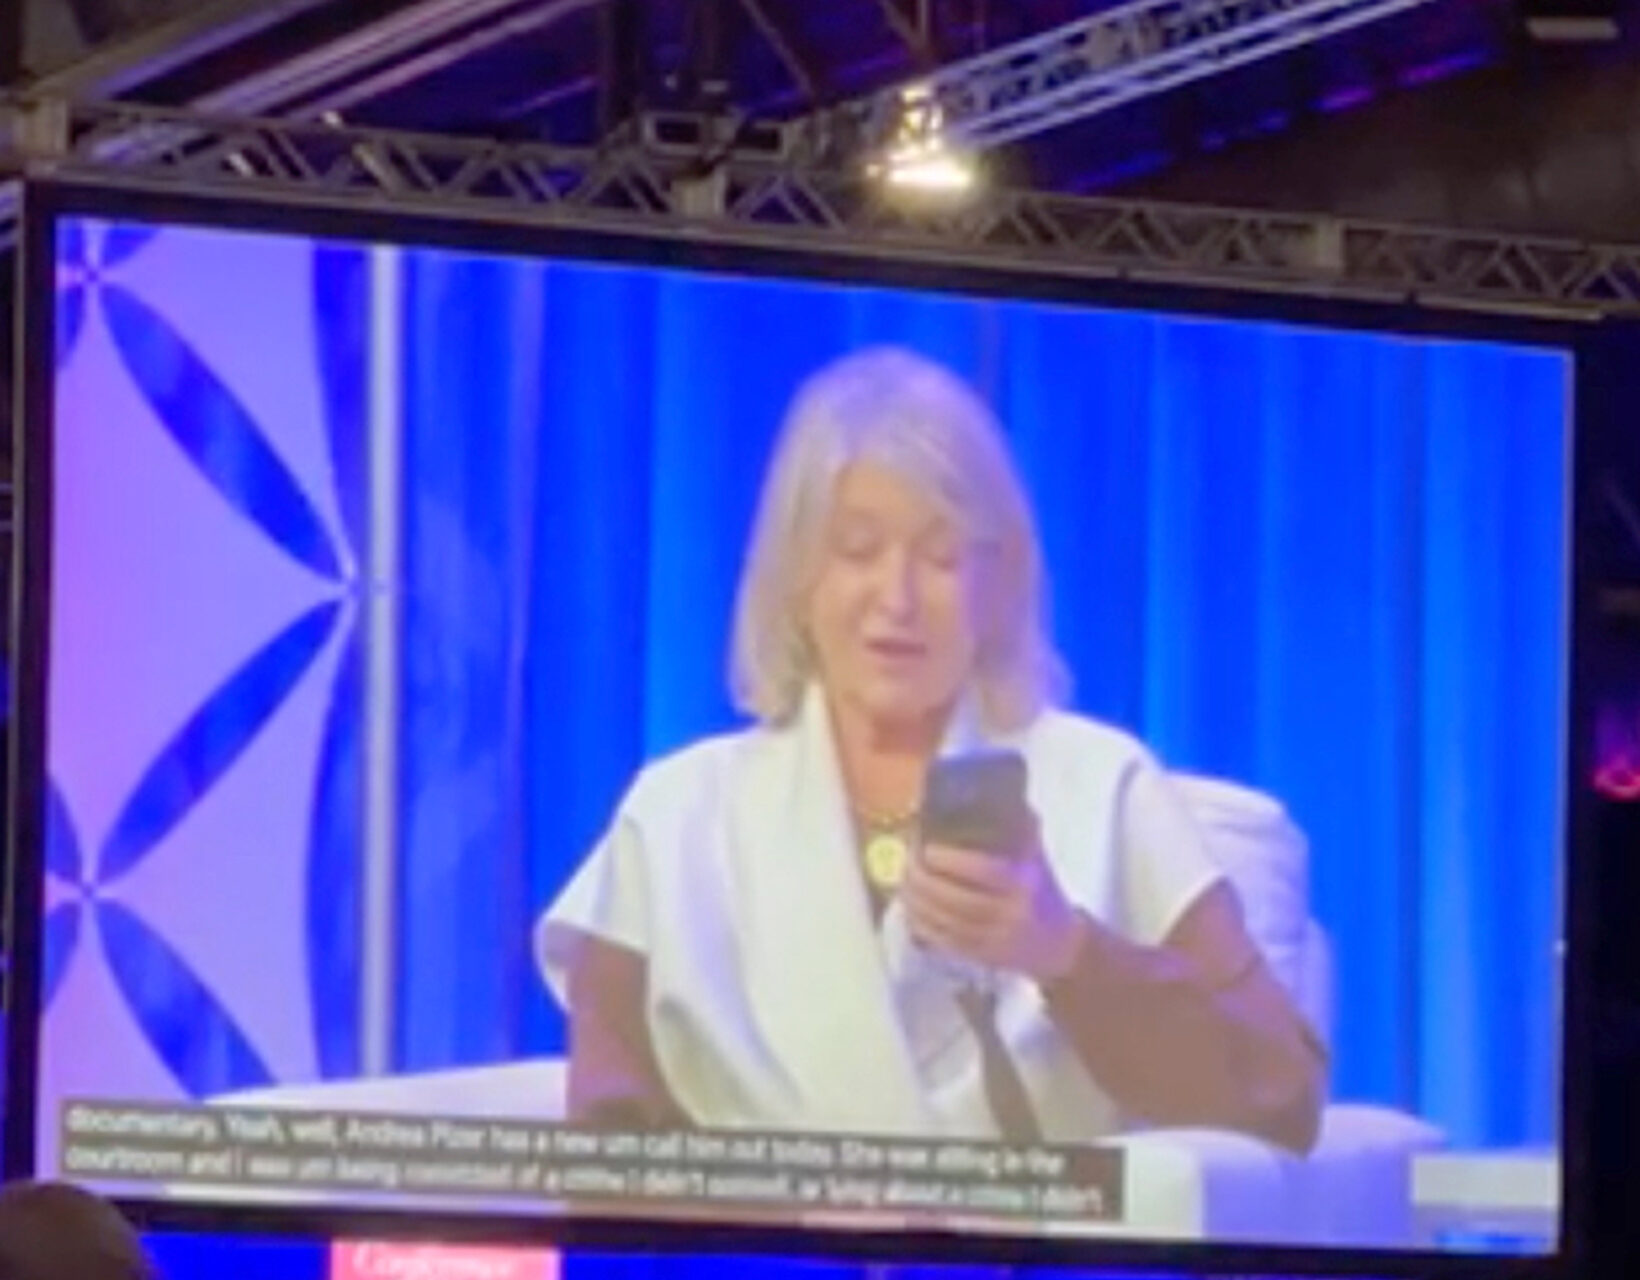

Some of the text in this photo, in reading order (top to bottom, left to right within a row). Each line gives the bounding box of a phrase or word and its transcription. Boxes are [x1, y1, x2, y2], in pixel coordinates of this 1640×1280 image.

[188, 1147, 229, 1175] and
[335, 1153, 397, 1189] being
[489, 1122, 528, 1151] has
[644, 1132, 682, 1158] call
[731, 1136, 768, 1161] out
[840, 1139, 882, 1168] She
[1026, 1147, 1065, 1175] the
